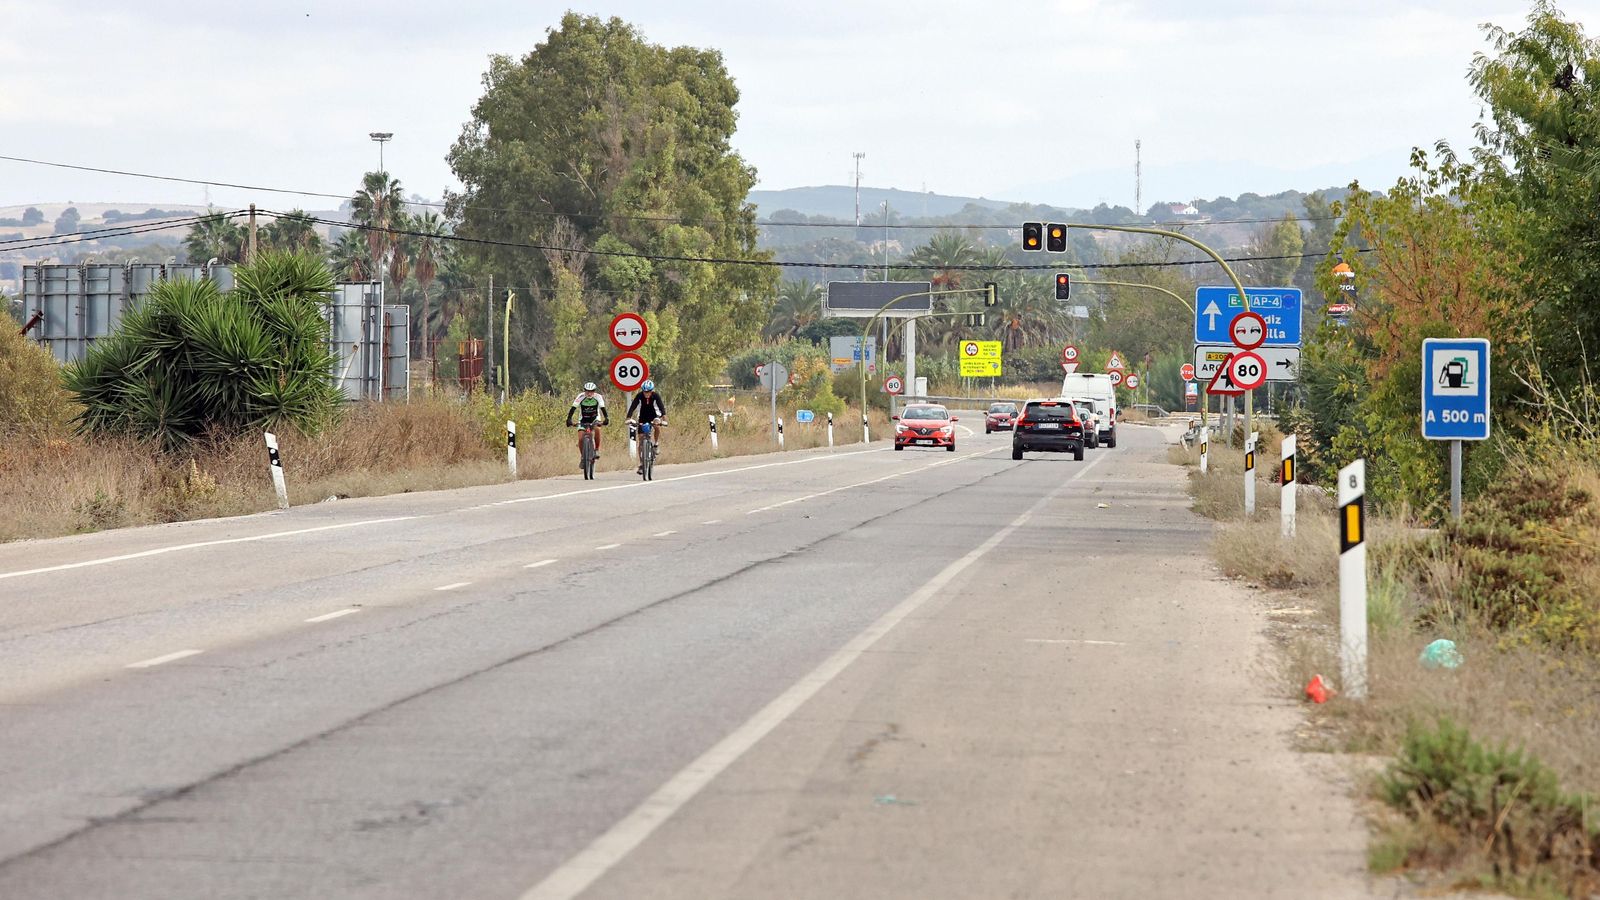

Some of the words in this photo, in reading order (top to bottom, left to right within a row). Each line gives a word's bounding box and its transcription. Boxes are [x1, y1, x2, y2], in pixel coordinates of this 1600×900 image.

[1253, 296, 1280, 306] AP-4
[1264, 314, 1281, 324] diz
[1266, 328, 1286, 339] illa
[618, 365, 640, 378] 80
[1238, 364, 1258, 377] 80
[888, 381, 899, 389] 80
[1426, 409, 1436, 423] A
[1442, 410, 1469, 423] 500
[1473, 412, 1485, 423] m
[1348, 474, 1358, 489] 8
